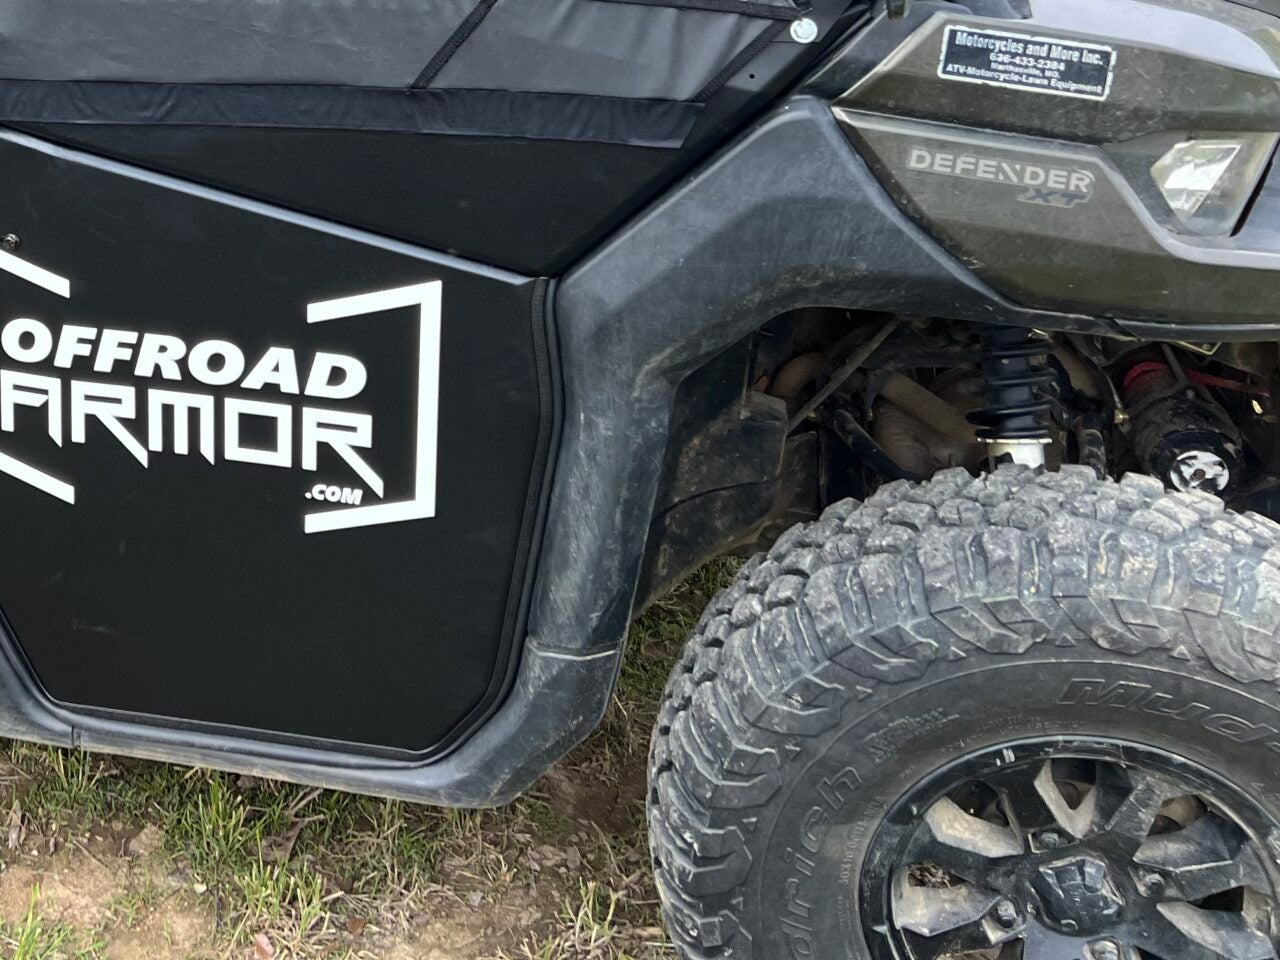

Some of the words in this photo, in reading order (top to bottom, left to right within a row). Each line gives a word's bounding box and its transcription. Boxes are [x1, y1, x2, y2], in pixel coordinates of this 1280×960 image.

[955, 31, 1023, 54] Motorcycles
[1026, 43, 1048, 58] and
[1050, 45, 1079, 63] More
[1082, 49, 1104, 66] Inc.
[1050, 78, 1103, 94] Equipment
[909, 148, 1093, 193] DEFENDER
[1024, 188, 1087, 206] XT
[0, 317, 368, 400] OFFROAD
[0, 369, 385, 500] ARMOR
[305, 483, 364, 506] .COM
